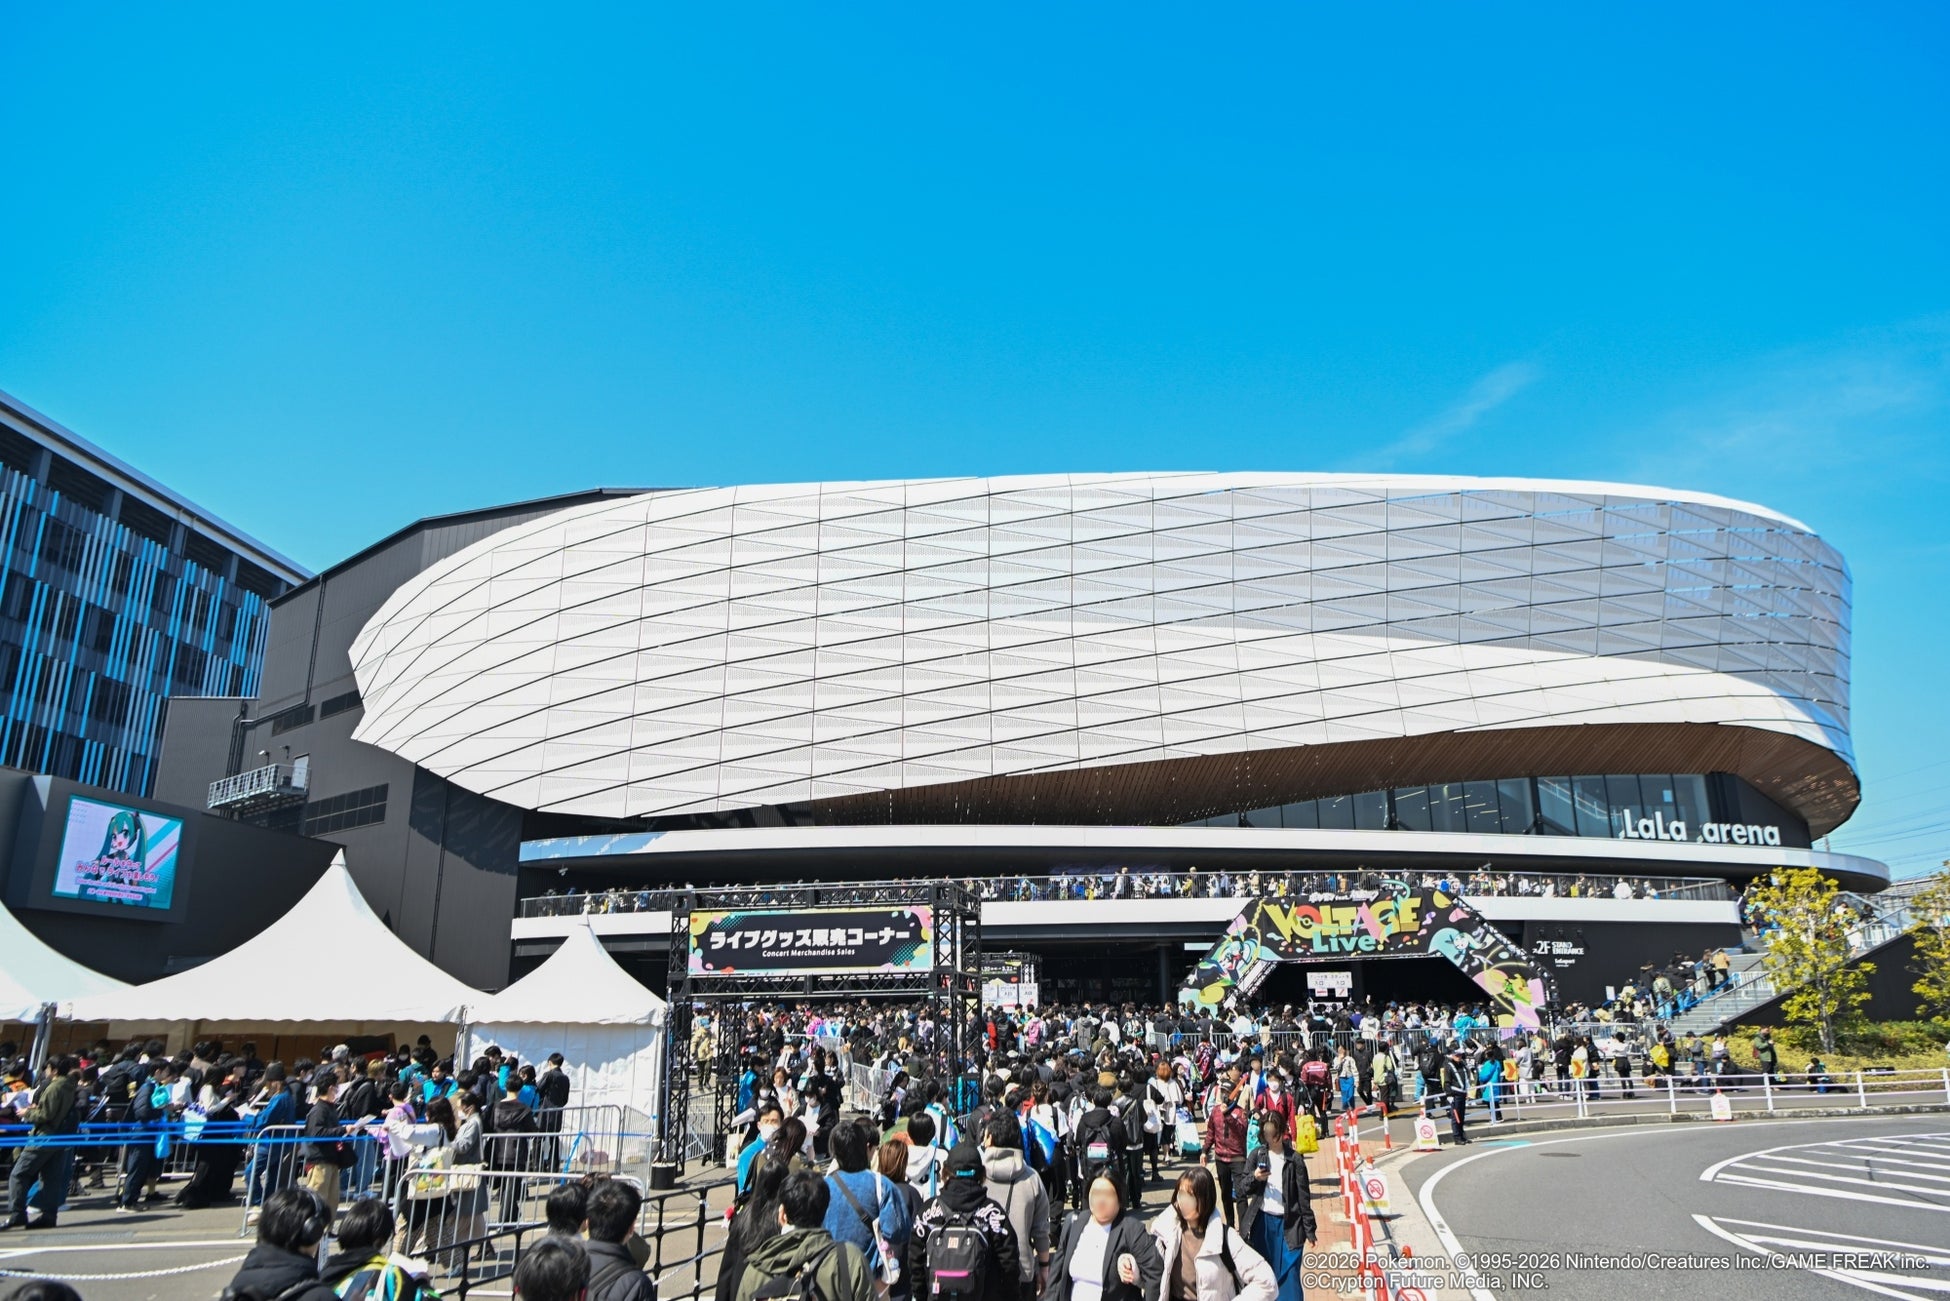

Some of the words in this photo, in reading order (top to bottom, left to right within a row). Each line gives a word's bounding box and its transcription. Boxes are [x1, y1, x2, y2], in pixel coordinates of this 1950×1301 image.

[1623, 809, 1688, 841] LaLa
[1702, 821, 1781, 846] arena
[1263, 896, 1422, 943] VOLTAGE
[710, 927, 910, 950] ライブグッズ販売コーナー
[1536, 940, 1551, 955] 2F
